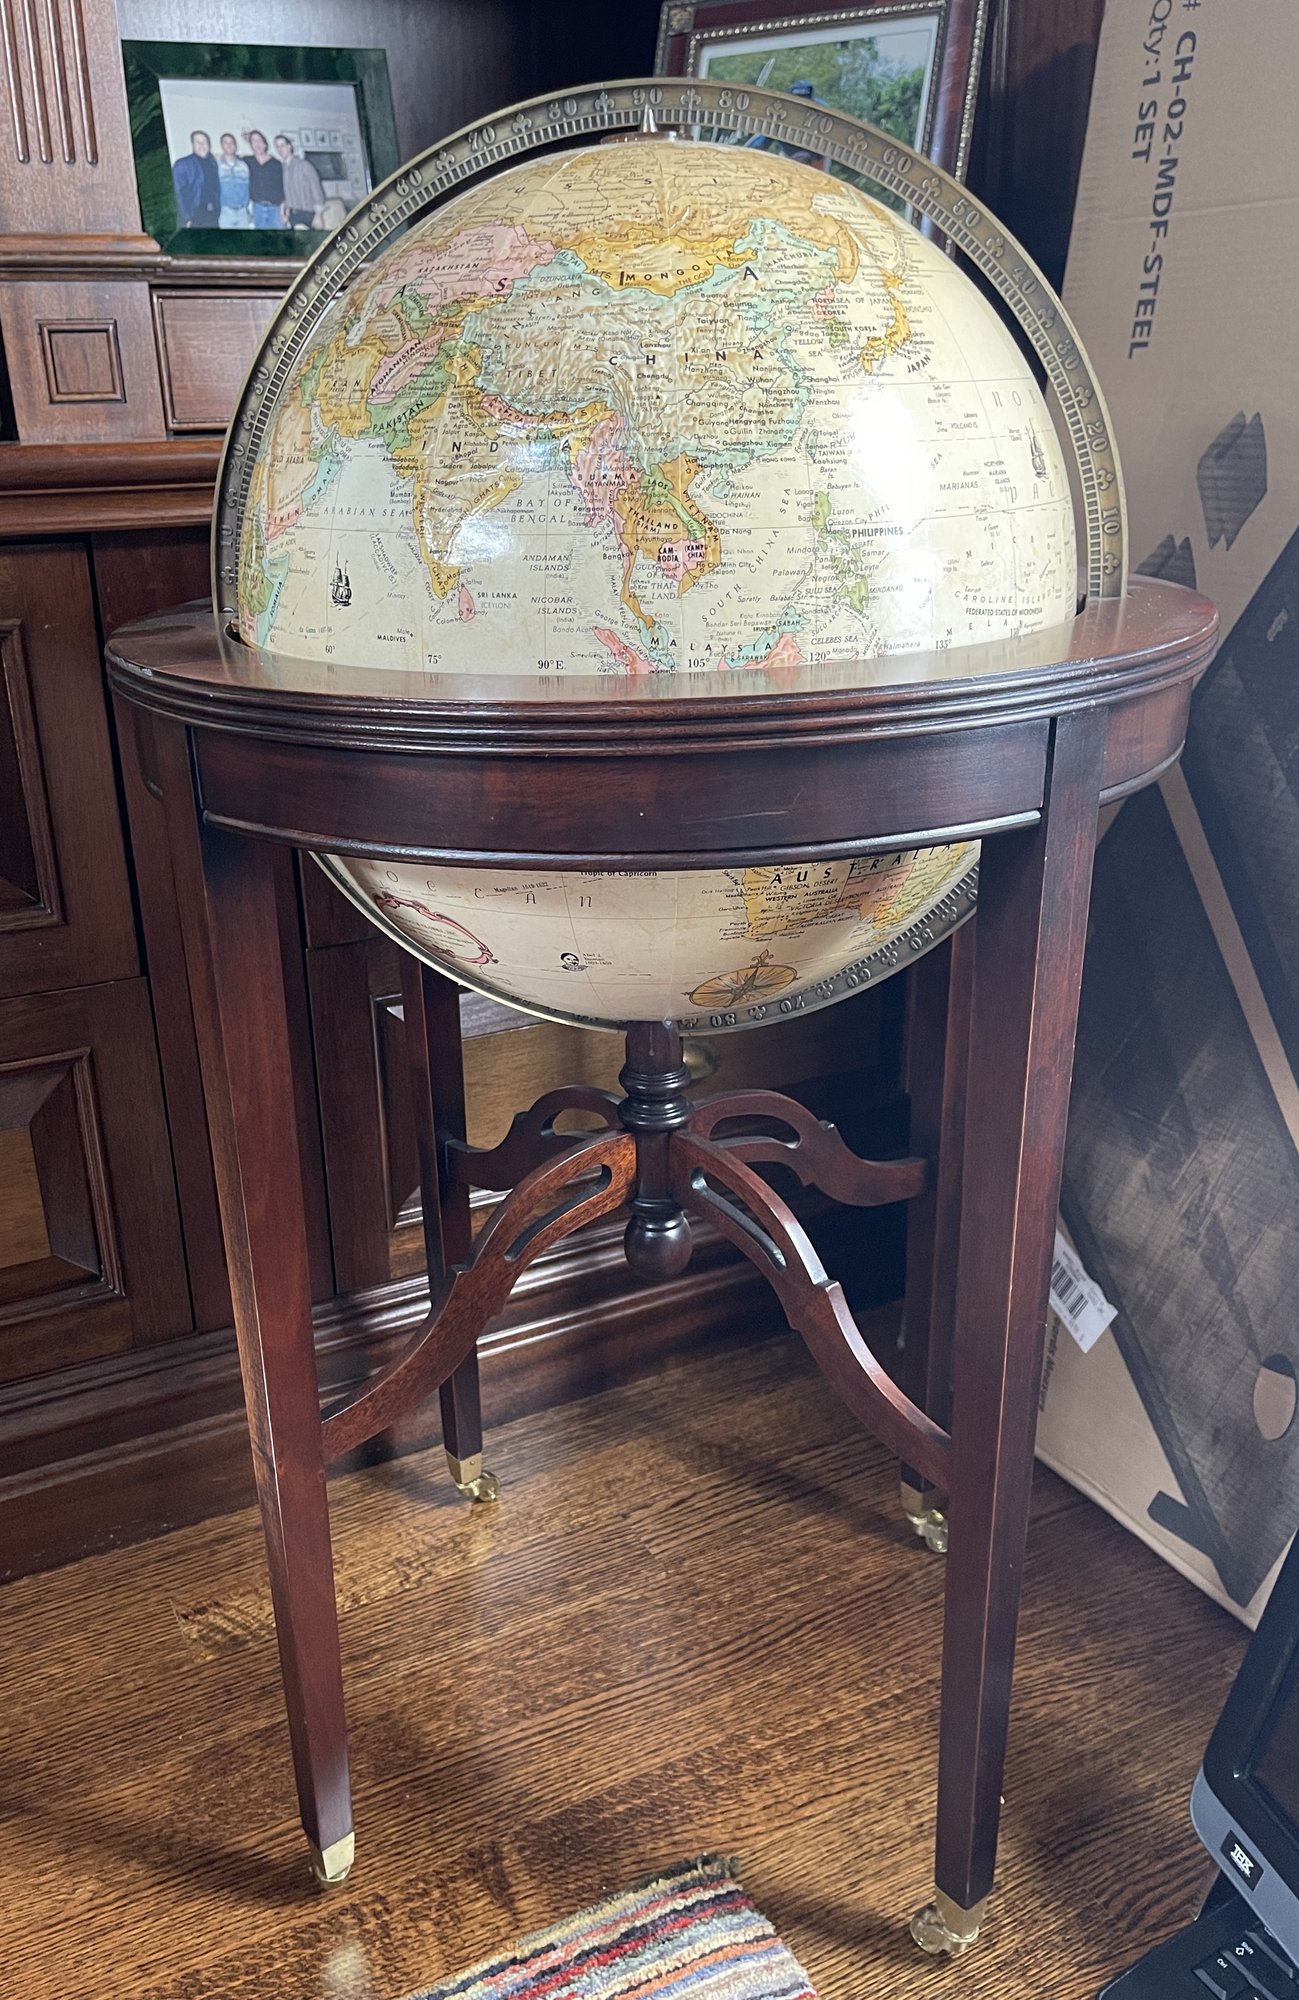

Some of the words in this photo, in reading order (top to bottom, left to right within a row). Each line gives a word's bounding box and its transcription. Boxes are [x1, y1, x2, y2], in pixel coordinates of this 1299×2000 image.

[632, 87, 663, 105] 90
[719, 90, 750, 111] 80
[546, 97, 578, 120] 80
[803, 110, 834, 133] 70
[467, 126, 498, 152] 70
[1132, 101, 1158, 163] SET
[882, 147, 912, 174] 60
[395, 166, 425, 197] 60
[1128, 30, 1197, 359] CH-02-MDF-STEEL
[952, 199, 980, 228] 50
[334, 224, 361, 255] 50
[1011, 266, 1037, 295] 40
[287, 292, 309, 321] 40
[697, 317, 730, 325] Taiyuan
[608, 348, 765, 366] CHINA
[1056, 338, 1078, 371] 30
[506, 369, 557, 378] TIBET
[907, 355, 931, 374] JAPAN
[253, 365, 271, 396] 30
[807, 375, 840, 383] Shanghai
[372, 401, 424, 432] PAKISTAN
[1087, 421, 1108, 453] 20
[647, 479, 668, 489] LAOS
[939, 481, 979, 491] MARIANAS
[324, 507, 376, 517] ARABIAN
[517, 499, 545, 507] BAY
[554, 499, 571, 507] OF
[510, 515, 566, 523] BENGAL
[1102, 507, 1120, 535] 10
[852, 527, 904, 536] PHILIPPINES
[701, 583, 742, 623] SOUTH
[750, 530, 780, 574] CHINA
[780, 487, 791, 514] SEA
[954, 590, 1013, 604] CAROLINE
[377, 634, 406, 642] MALDIVES
[650, 637, 772, 651] MALAYSIA
[811, 636, 842, 645] CELEBES
[428, 654, 442, 664] 75°
[538, 660, 554, 669] 90°
[688, 658, 710, 668] 105°
[809, 651, 831, 662] 120°
[1216, 1957, 1228, 1969] Ctrl
